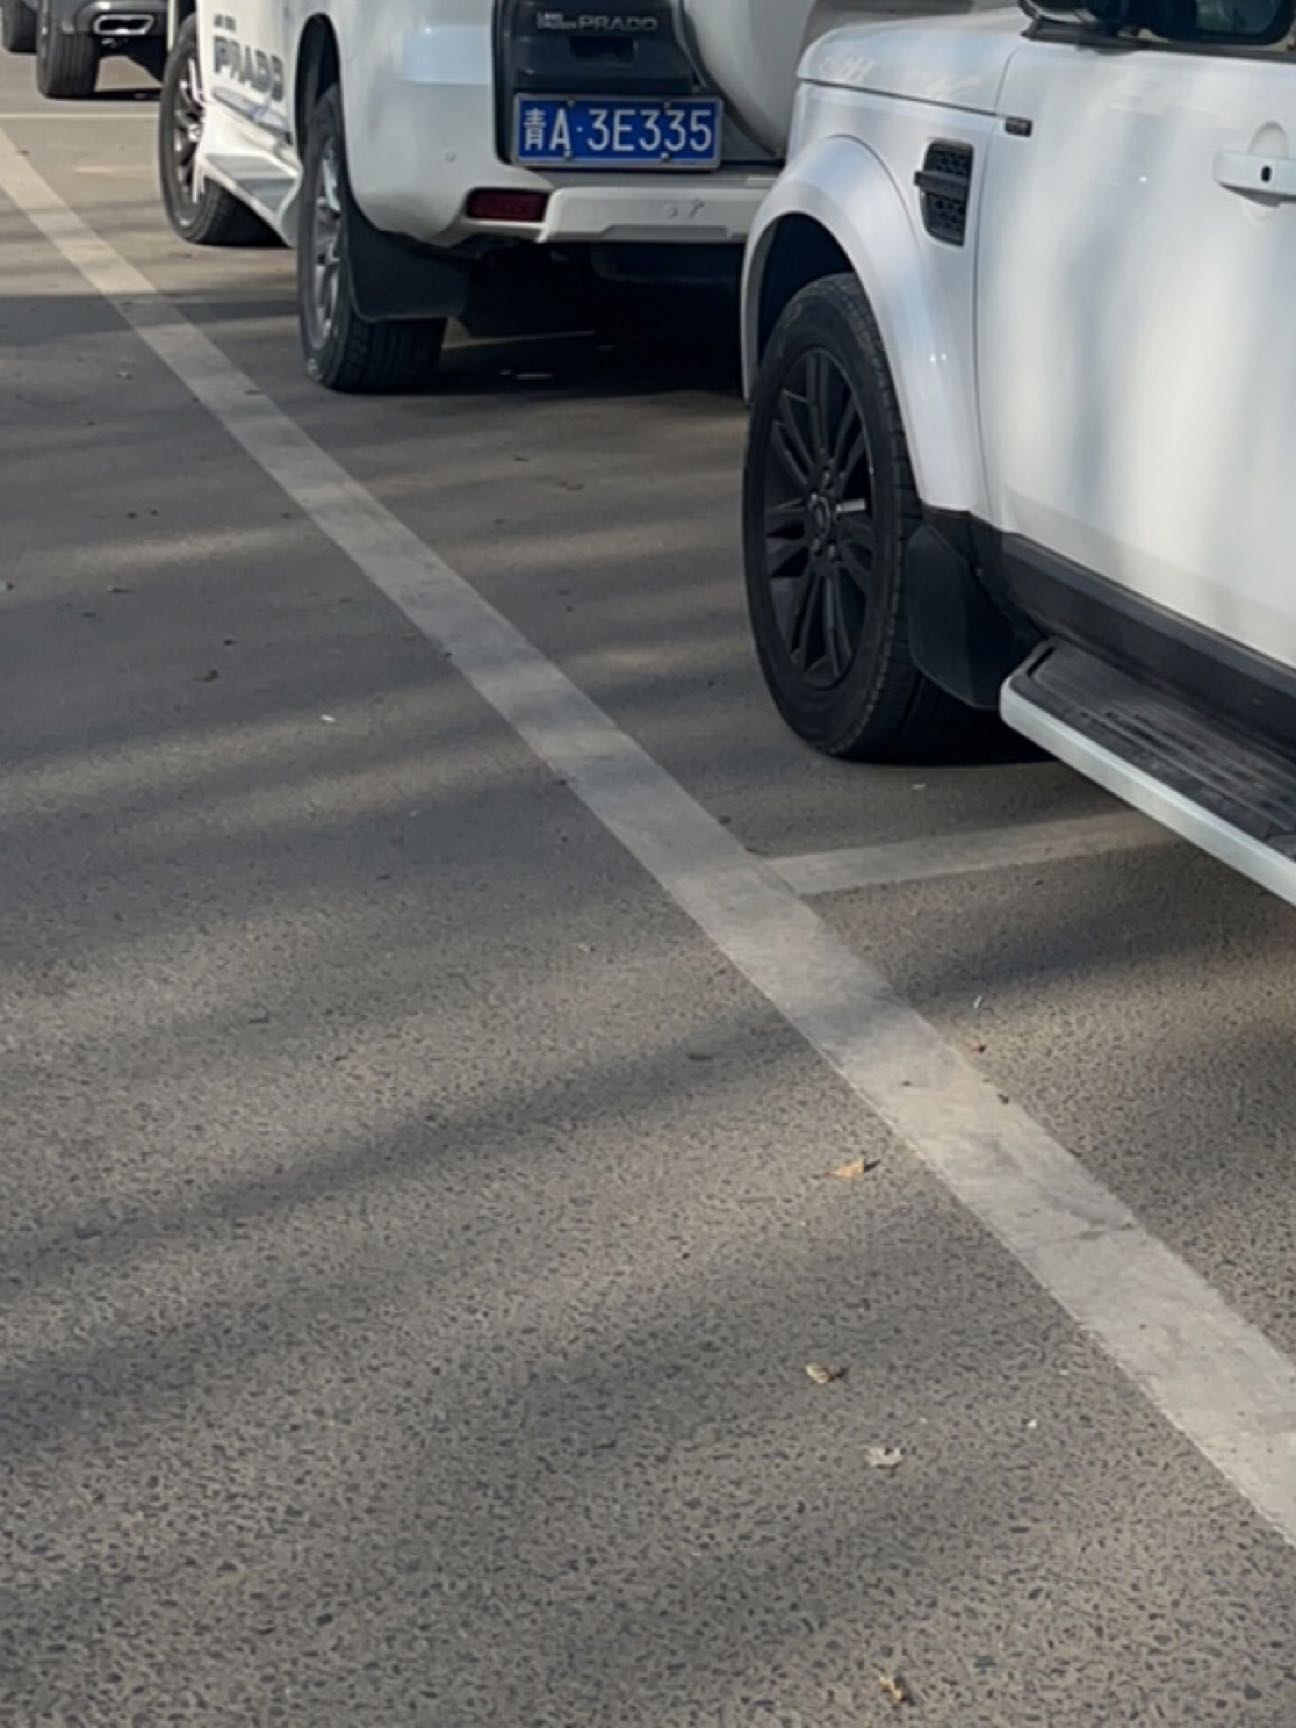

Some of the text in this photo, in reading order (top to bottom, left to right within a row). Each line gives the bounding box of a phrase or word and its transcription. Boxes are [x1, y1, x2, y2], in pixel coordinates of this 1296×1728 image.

[578, 14, 658, 31] PRADO
[213, 35, 284, 102] PRADO
[523, 107, 713, 156] 青A·3E335
